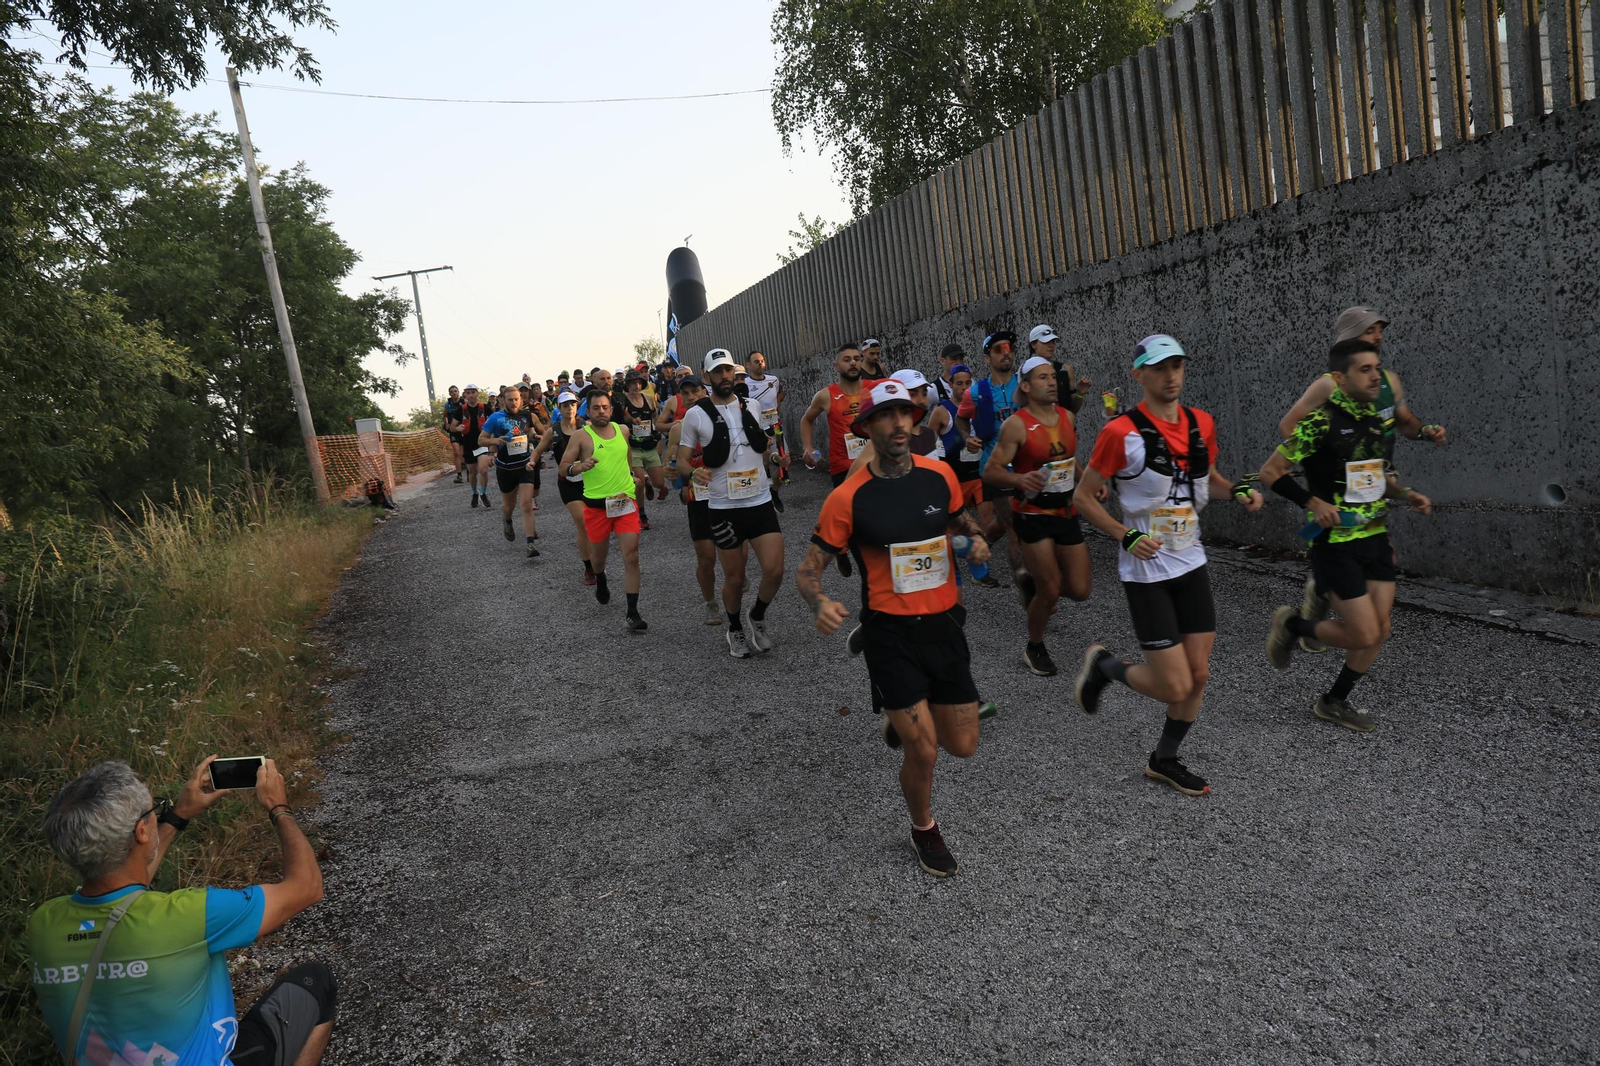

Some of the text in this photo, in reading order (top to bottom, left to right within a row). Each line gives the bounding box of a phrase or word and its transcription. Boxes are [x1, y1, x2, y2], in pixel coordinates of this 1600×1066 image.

[741, 477, 752, 487] 54
[617, 500, 626, 508] 75
[1172, 520, 1187, 532] 11
[915, 556, 932, 571] 30
[67, 932, 87, 942] FGM
